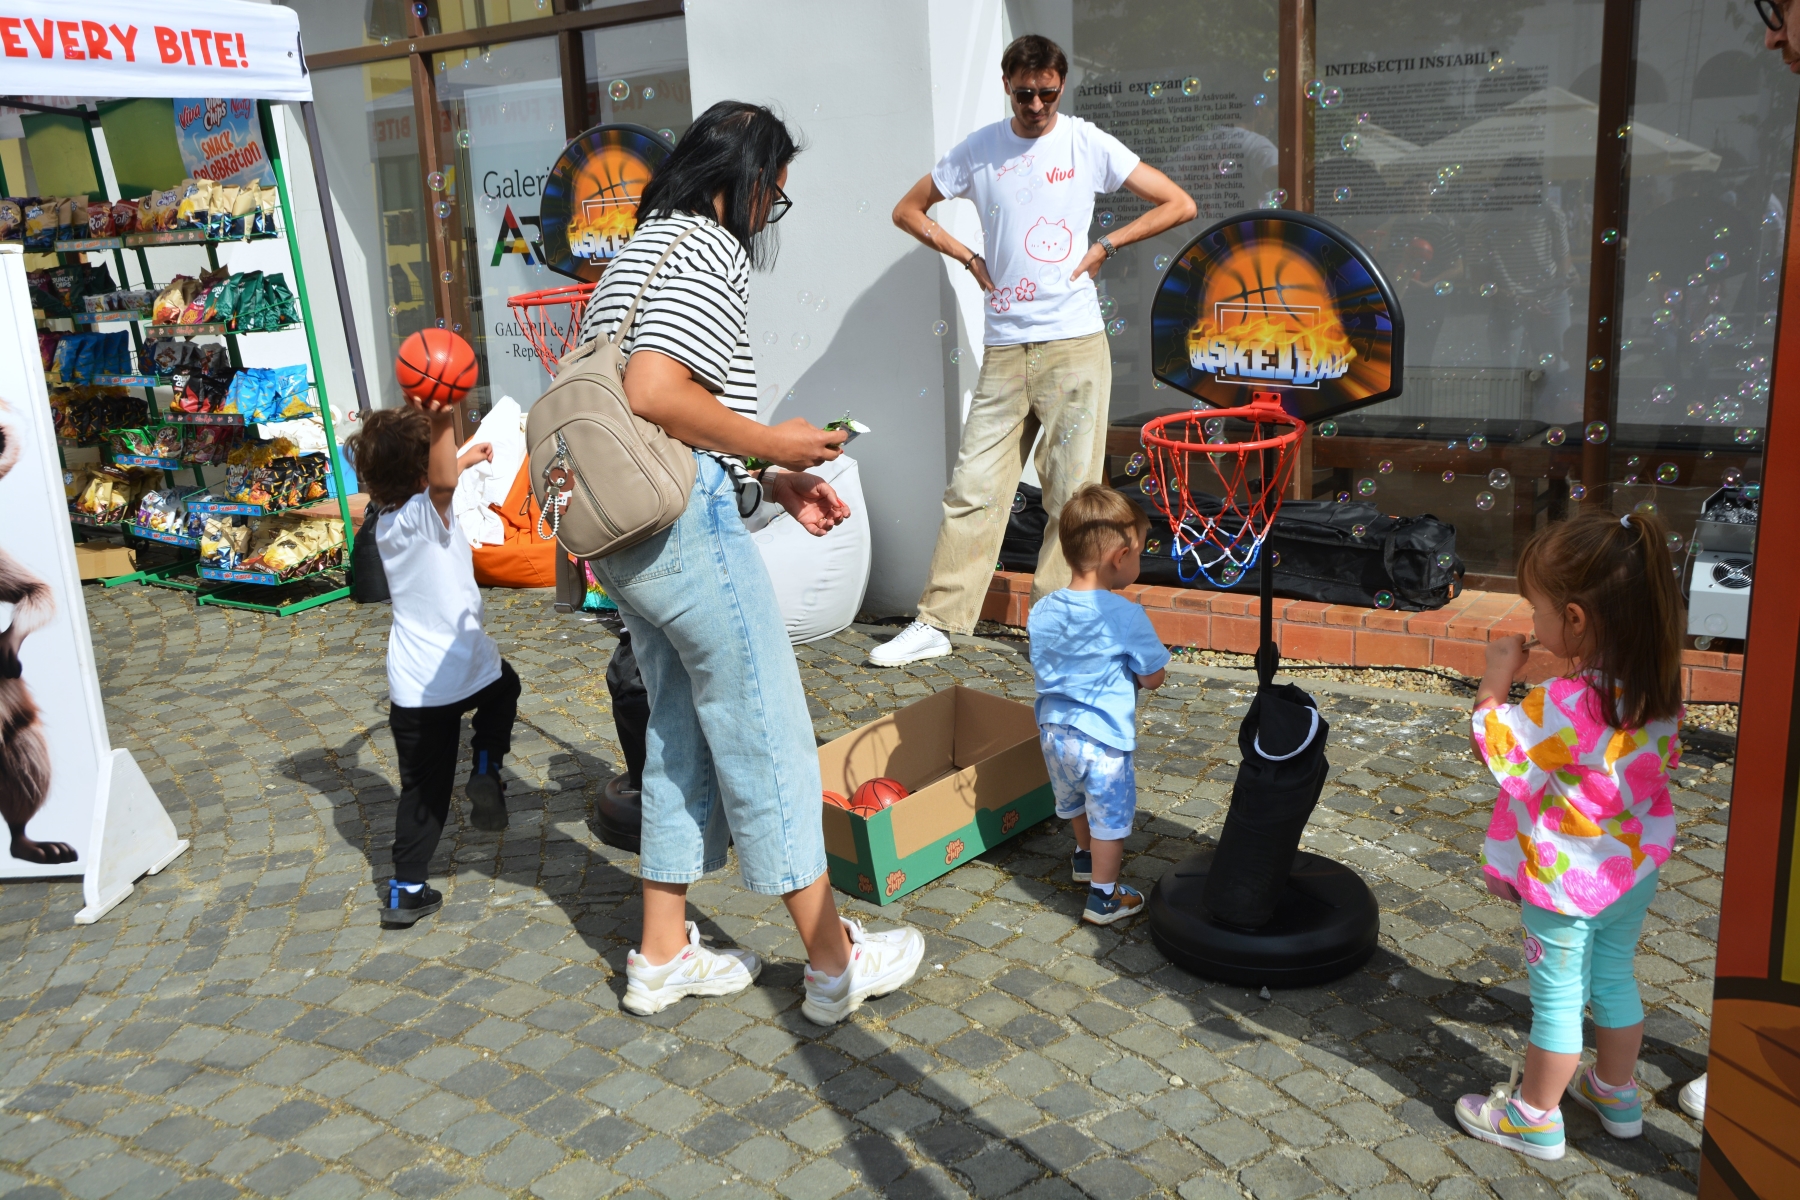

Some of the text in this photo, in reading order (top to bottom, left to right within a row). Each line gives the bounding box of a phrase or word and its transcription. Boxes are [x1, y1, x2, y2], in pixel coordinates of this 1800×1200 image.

[0, 16, 249, 69] EVERY BITE!
[178, 103, 202, 130] Viva
[203, 101, 228, 131] Chips
[201, 130, 235, 160] SNACK
[1046, 166, 1074, 184] Viva
[944, 841, 964, 865] Chips
[945, 838, 961, 855] Viva
[885, 873, 906, 897] Chips
[886, 869, 903, 886] Viva
